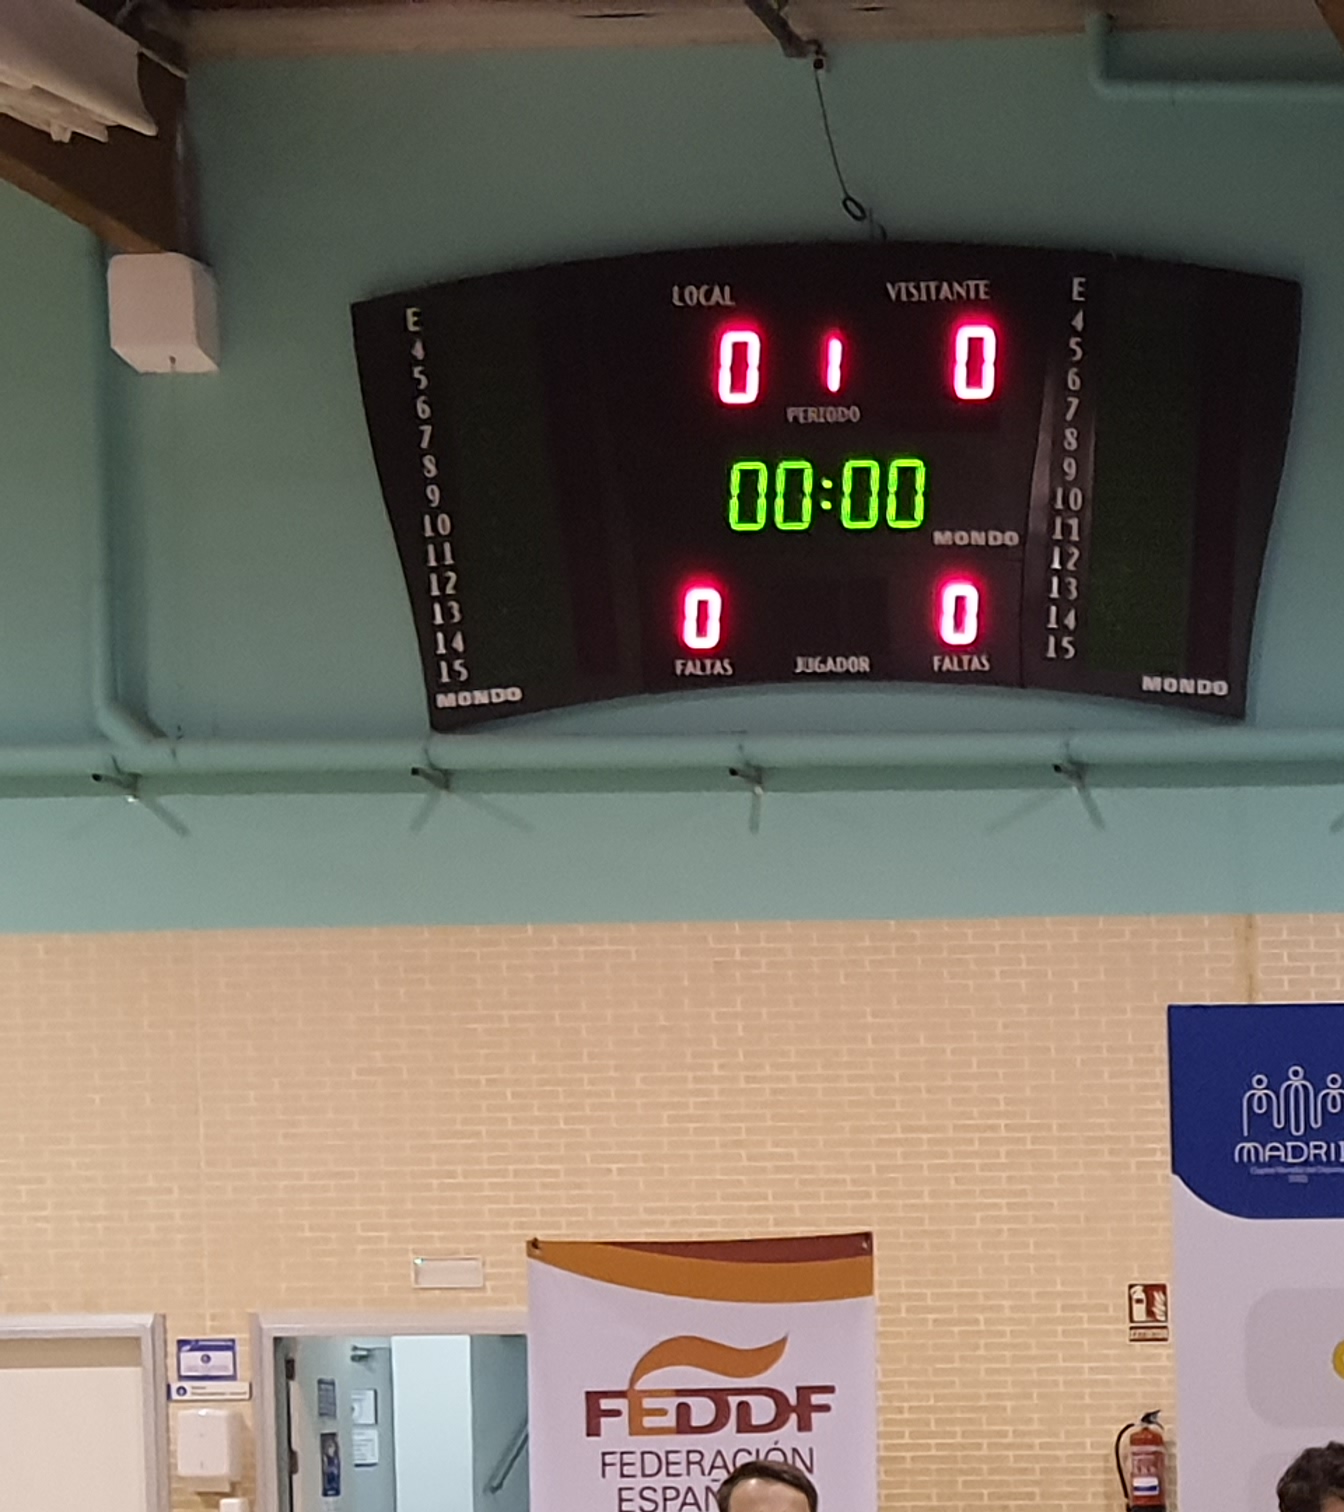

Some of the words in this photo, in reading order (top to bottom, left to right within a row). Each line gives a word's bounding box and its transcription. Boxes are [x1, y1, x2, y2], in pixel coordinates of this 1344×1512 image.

[671, 284, 736, 307] LOCAL
[886, 279, 991, 303] VISITANTE
[1072, 277, 1086, 302] E
[406, 307, 423, 332] E
[1071, 309, 1084, 331] 4
[411, 339, 425, 360] 4
[1069, 337, 1083, 361] 5
[718, 330, 761, 405] 0
[953, 324, 997, 400] 0
[413, 366, 428, 390] 5
[1067, 367, 1081, 390] 6
[415, 395, 431, 420] 6
[785, 406, 861, 424] PERIODO
[1065, 397, 1079, 421] 7
[418, 425, 433, 449] 7
[1063, 427, 1078, 451] 8
[422, 454, 438, 478] 8
[1062, 457, 1076, 481] 9
[426, 484, 440, 508] 9
[728, 458, 926, 532] 00:00
[1053, 486, 1083, 511] 10
[423, 513, 452, 537] 10
[1051, 517, 1080, 541] 11
[933, 531, 1020, 547] MONDO
[426, 542, 455, 566] 11
[1050, 547, 1080, 571] 12
[429, 571, 458, 595] 12
[1049, 576, 1078, 600] 13
[432, 601, 462, 625] 13
[683, 586, 723, 650] 0
[939, 582, 979, 645] 0
[1047, 606, 1076, 631] 14
[435, 631, 465, 654] 14
[1046, 635, 1075, 660] 15
[439, 659, 469, 683] 15
[674, 659, 733, 676] FALTAS
[794, 656, 870, 674] JUGADOR
[933, 655, 991, 672] FALTAS
[436, 686, 523, 708] MONDO
[1141, 675, 1229, 696] MONDO
[584, 1385, 836, 1437] FEDDF
